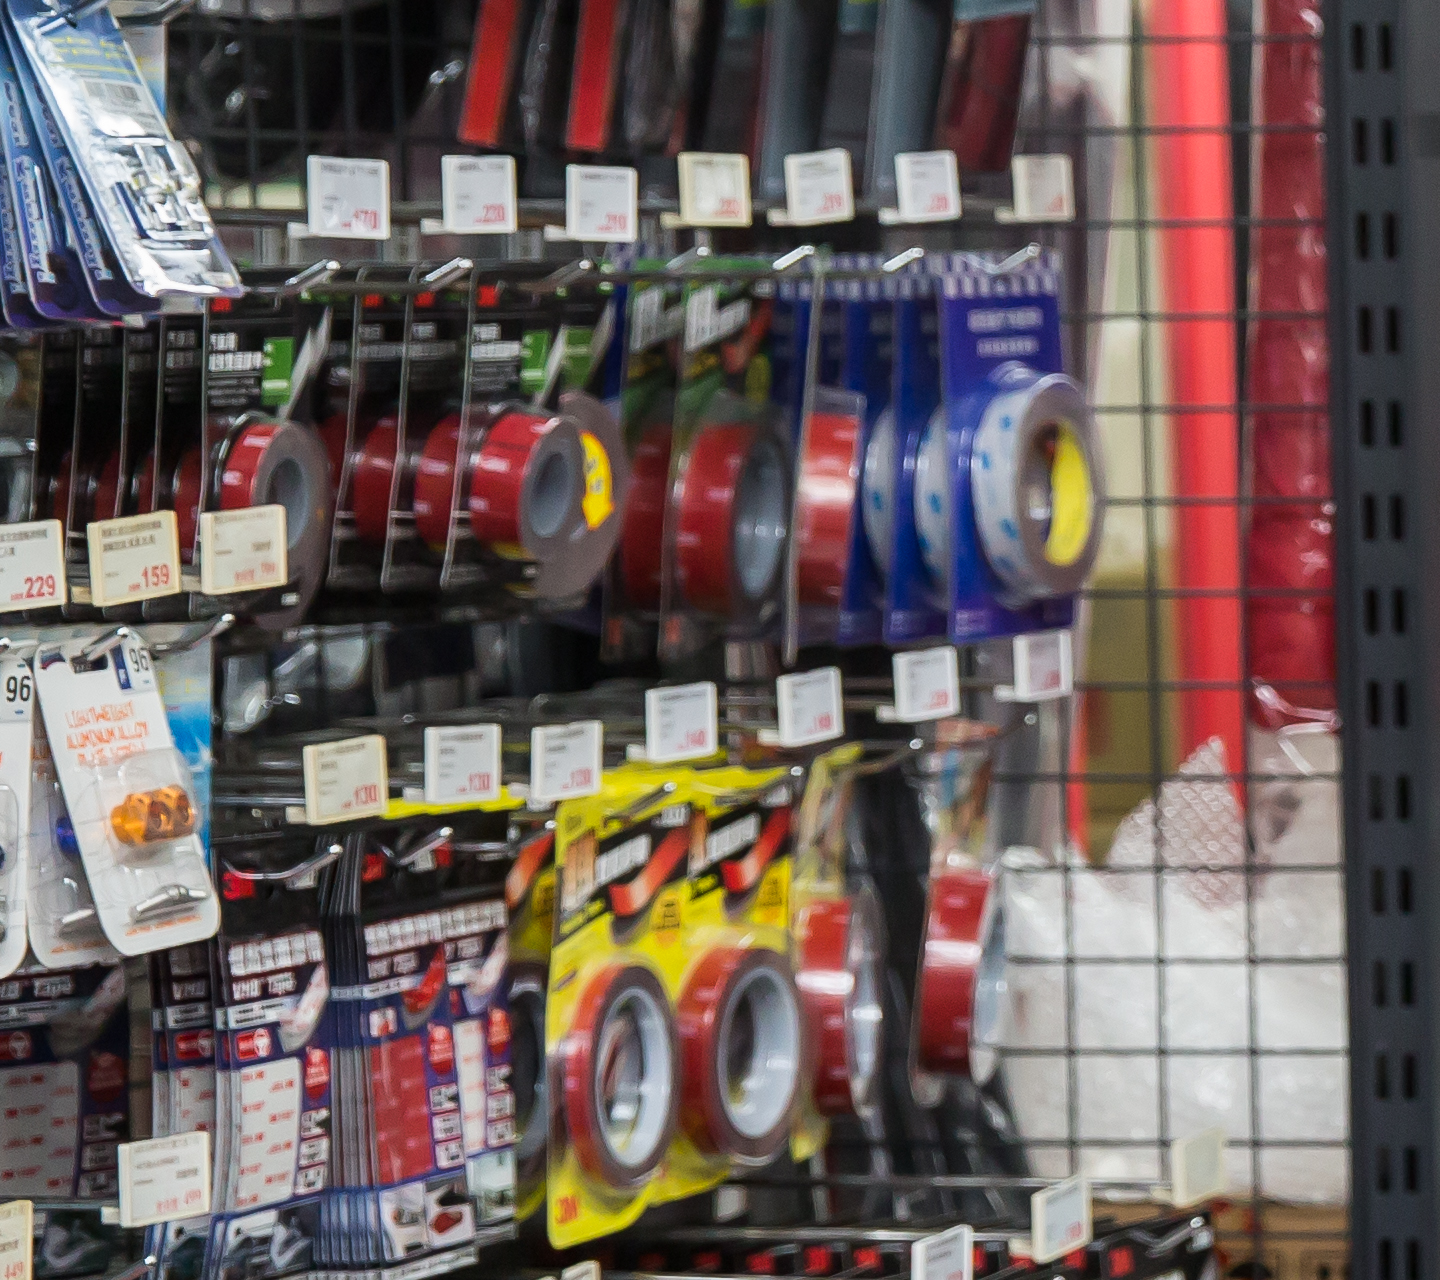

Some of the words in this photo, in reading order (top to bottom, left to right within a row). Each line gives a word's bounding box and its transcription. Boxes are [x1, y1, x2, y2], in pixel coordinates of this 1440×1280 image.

[24, 574, 56, 599] 229
[141, 564, 170, 588] 159
[6, 676, 31, 702] 96
